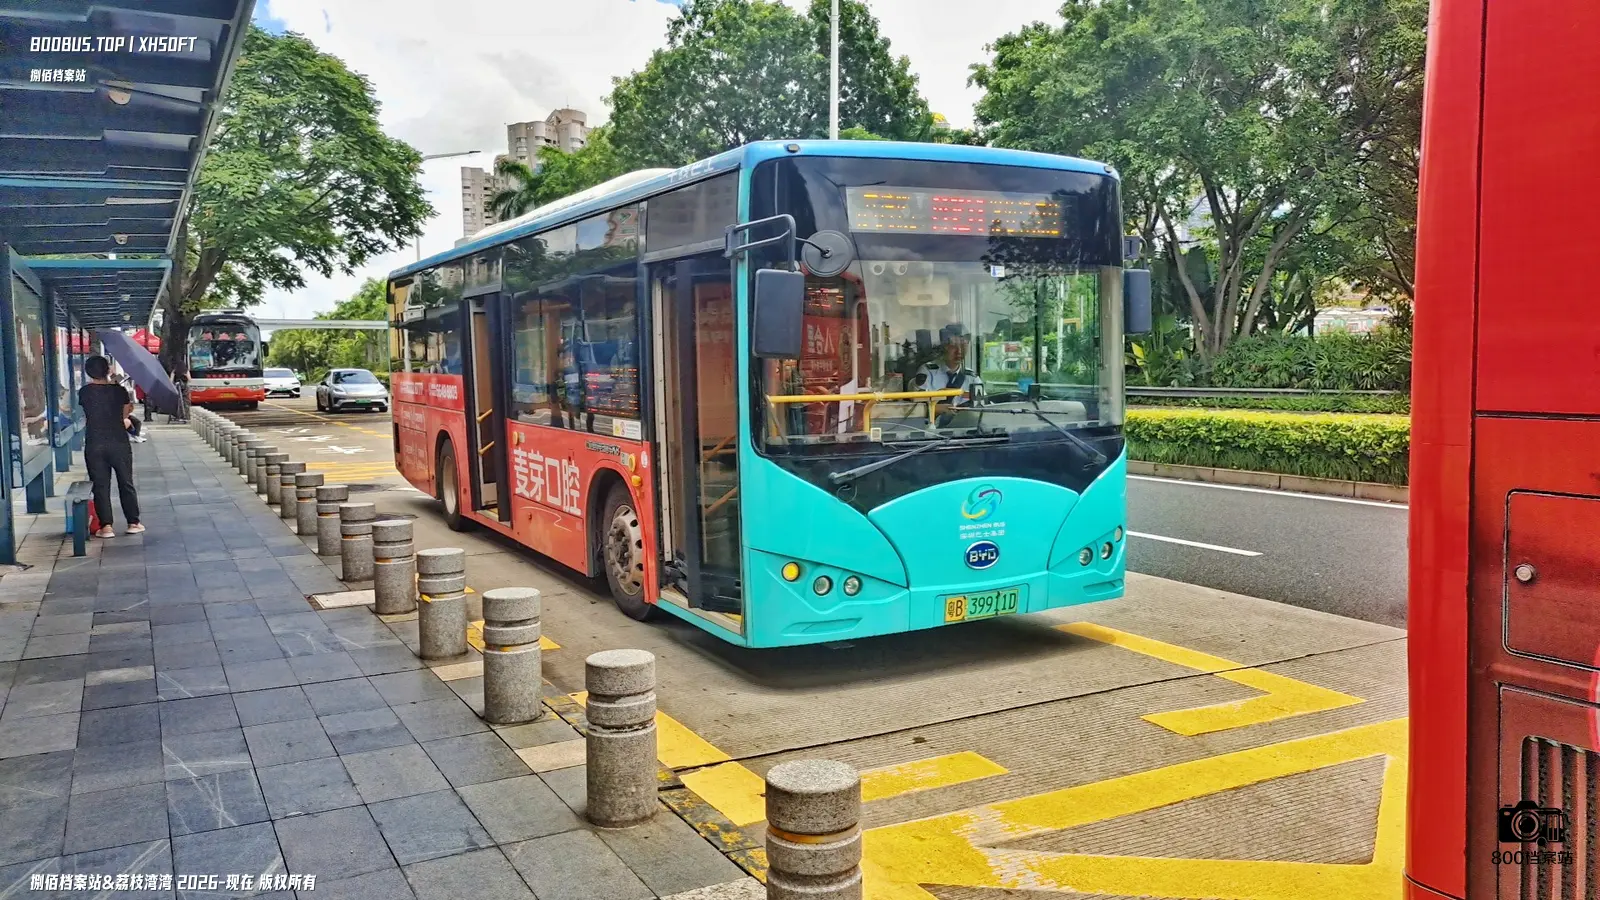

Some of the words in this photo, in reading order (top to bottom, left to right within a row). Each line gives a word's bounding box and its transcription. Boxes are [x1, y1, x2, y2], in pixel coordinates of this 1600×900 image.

[513, 449, 582, 516] 麦芽口腔
[969, 548, 996, 563] BYD
